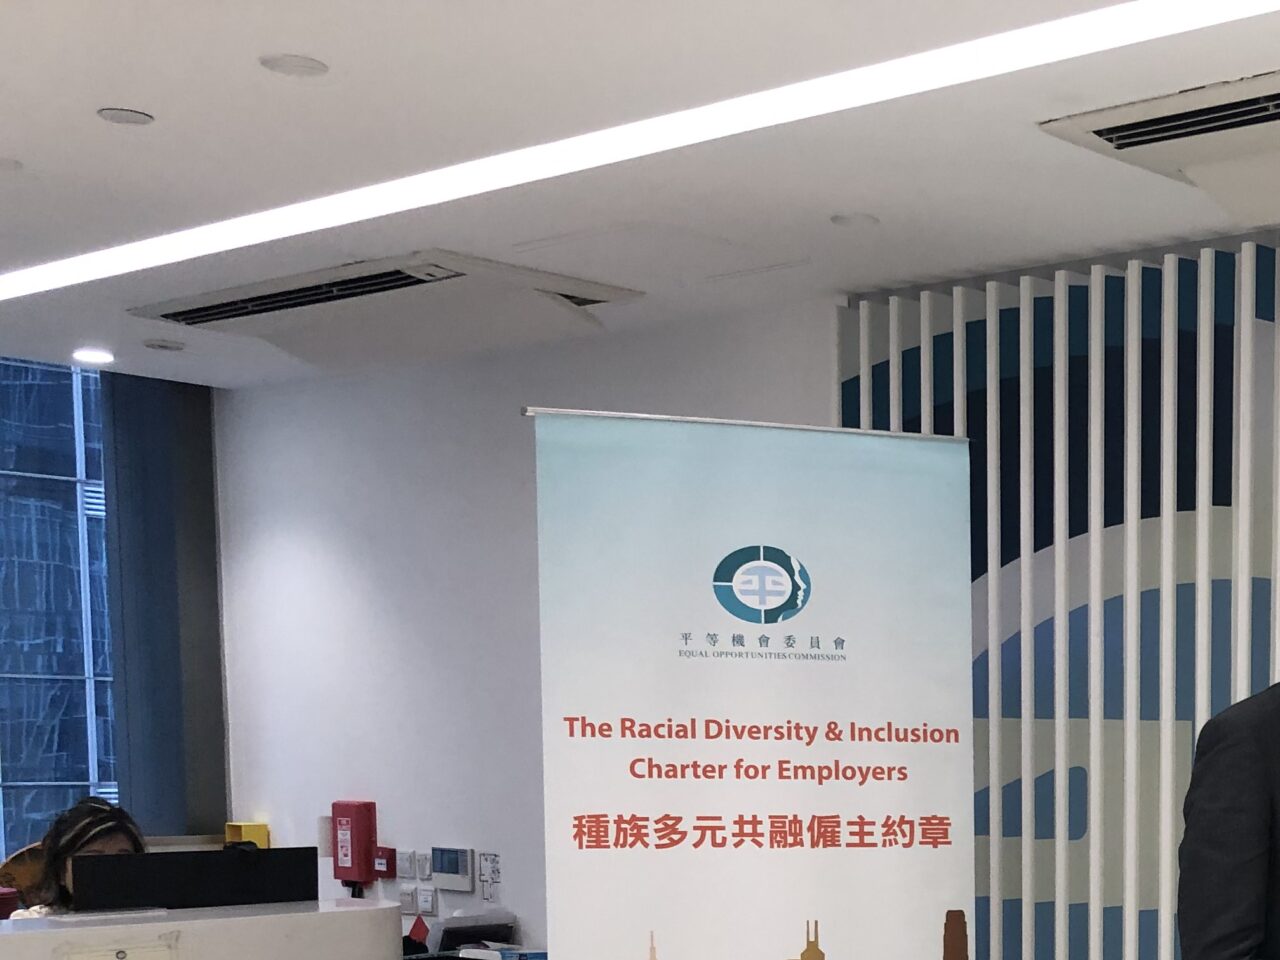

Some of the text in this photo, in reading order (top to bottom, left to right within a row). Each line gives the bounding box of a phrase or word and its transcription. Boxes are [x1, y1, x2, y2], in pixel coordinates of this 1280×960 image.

[679, 632, 846, 650] 平等機會委員會
[679, 650, 847, 661] EQUAL OPPORTUNITIES COMMISSION
[564, 716, 960, 746] The Racial Diversity & Inclusion
[629, 758, 908, 786] Charter for Employers
[573, 814, 952, 850] 種族多元共融僱主約章
